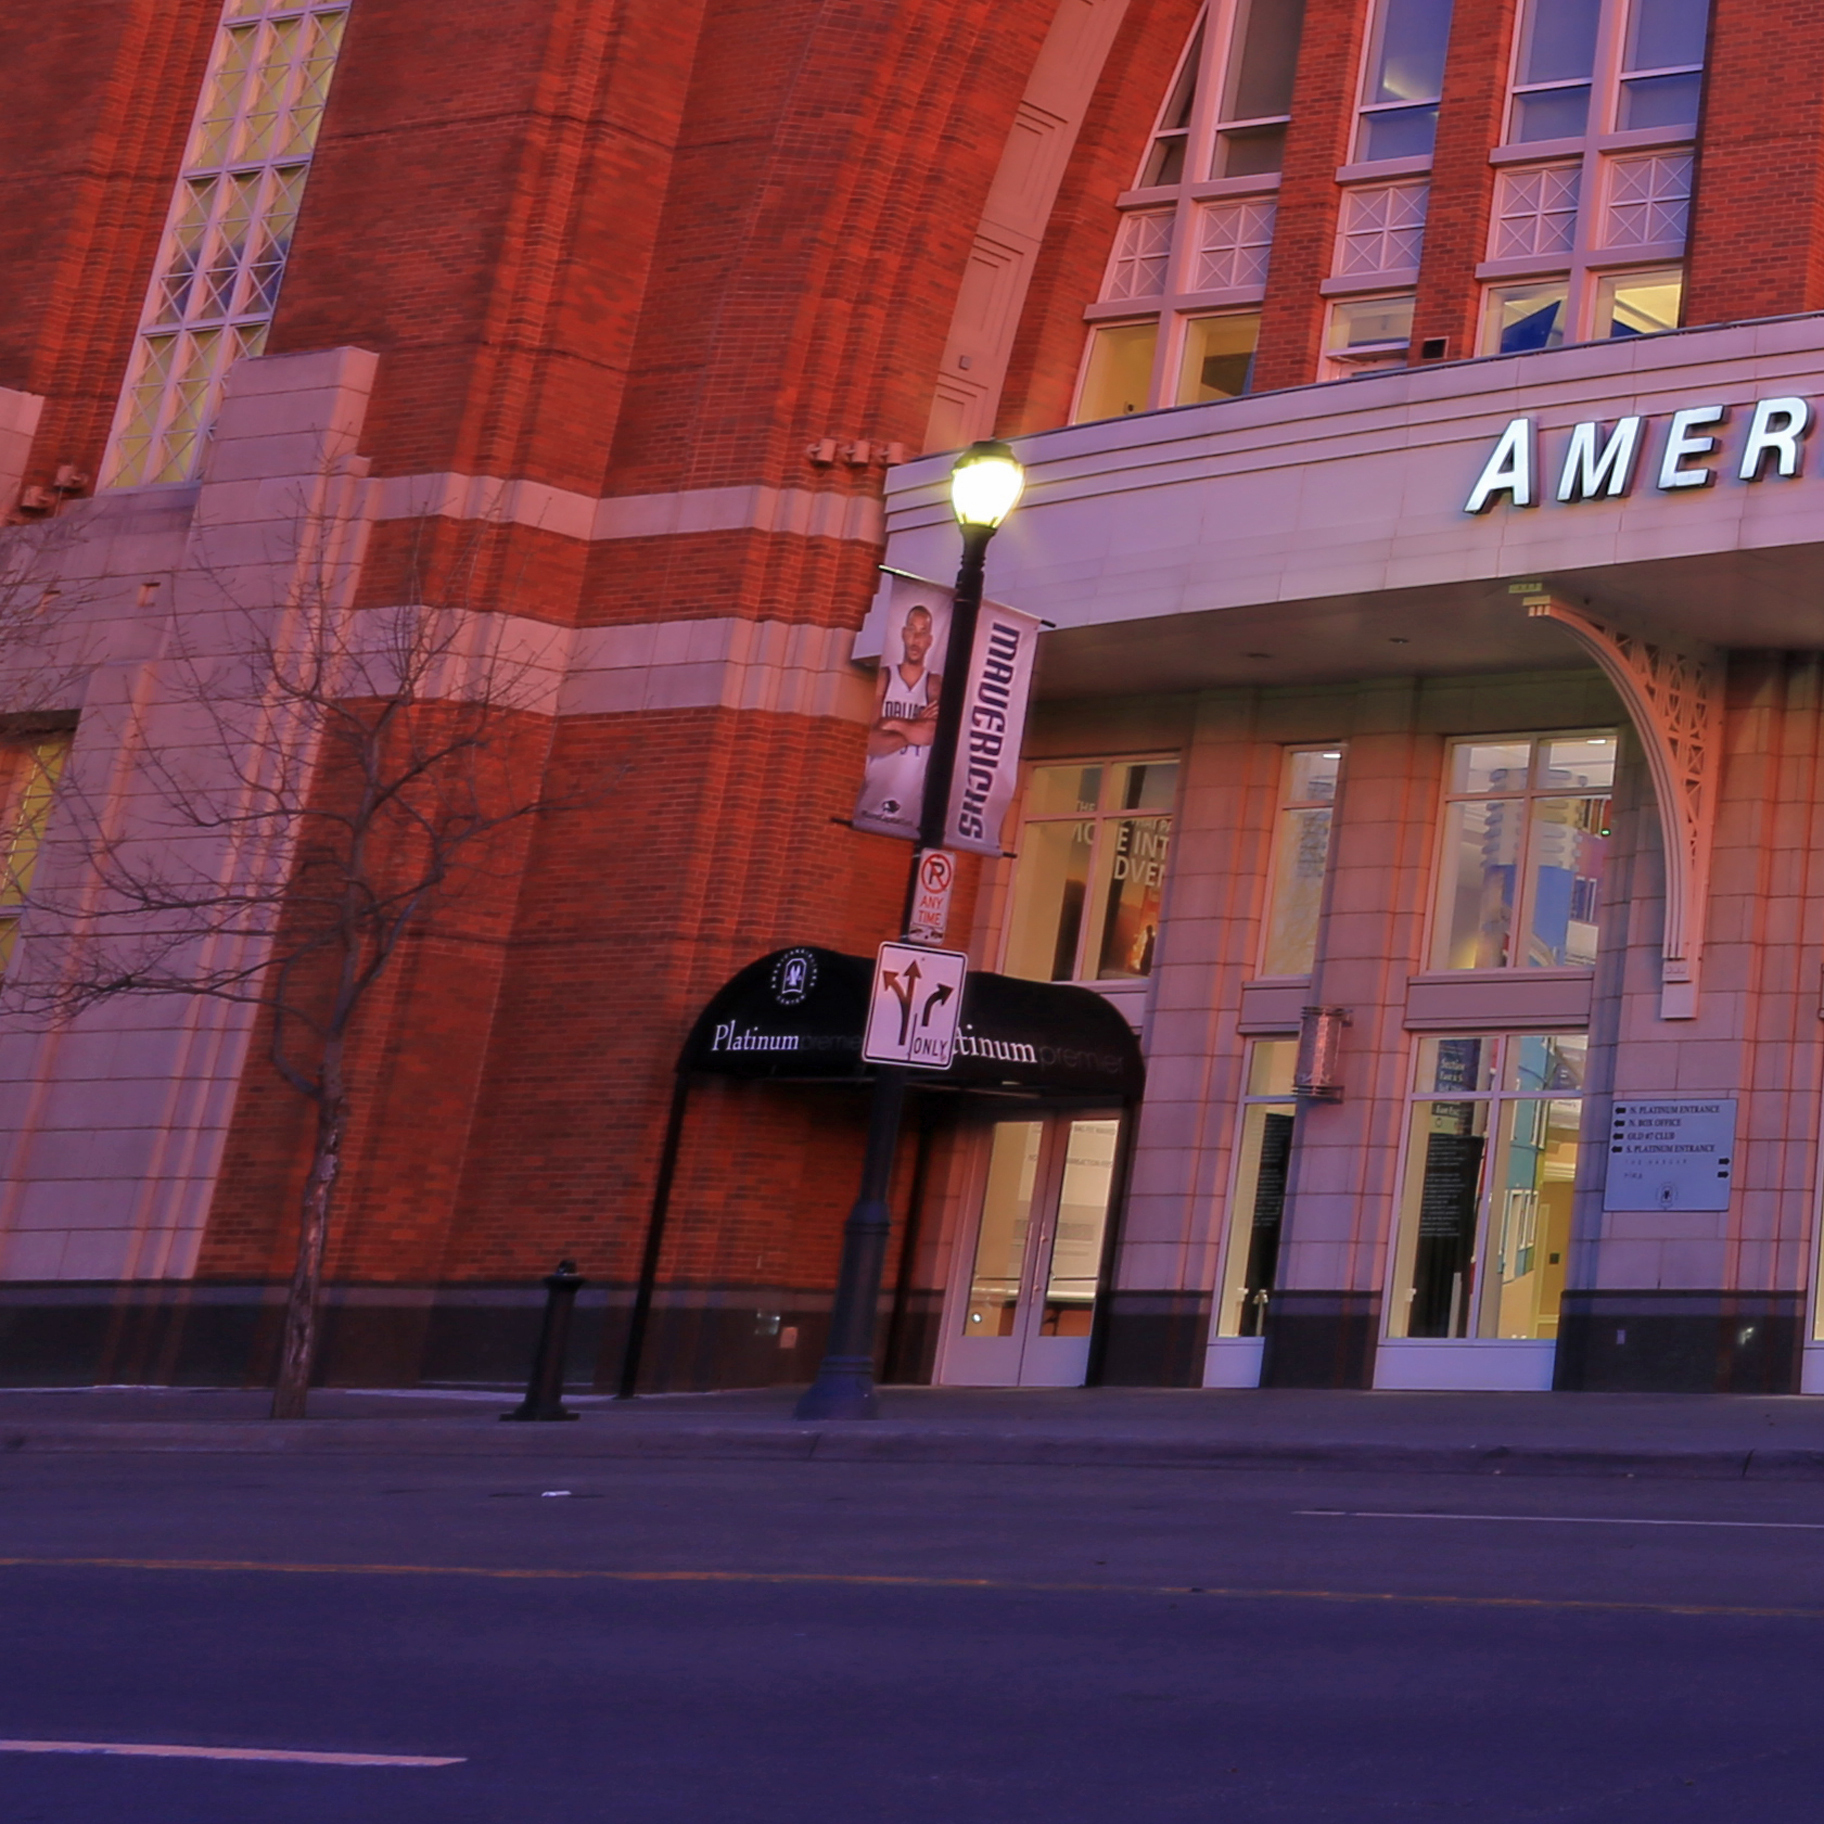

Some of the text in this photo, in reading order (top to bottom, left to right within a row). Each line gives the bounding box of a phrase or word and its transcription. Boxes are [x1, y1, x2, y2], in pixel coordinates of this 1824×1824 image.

[958, 622, 1021, 840] MAVERICKS
[1113, 855, 1165, 888] DVE
[920, 895, 943, 910] ANY
[917, 910, 942, 926] TIME
[711, 1019, 800, 1052] Platinum
[952, 1024, 1038, 1064] tinum
[913, 1037, 948, 1057] ONLY
[1639, 1105, 1678, 1114] PLATINUM
[1680, 1104, 1719, 1114] ENTRANCE
[1654, 1118, 1681, 1127] OFFICE
[1634, 1145, 1673, 1153] PLATINUM
[1674, 1144, 1715, 1153] ENTRANCE
